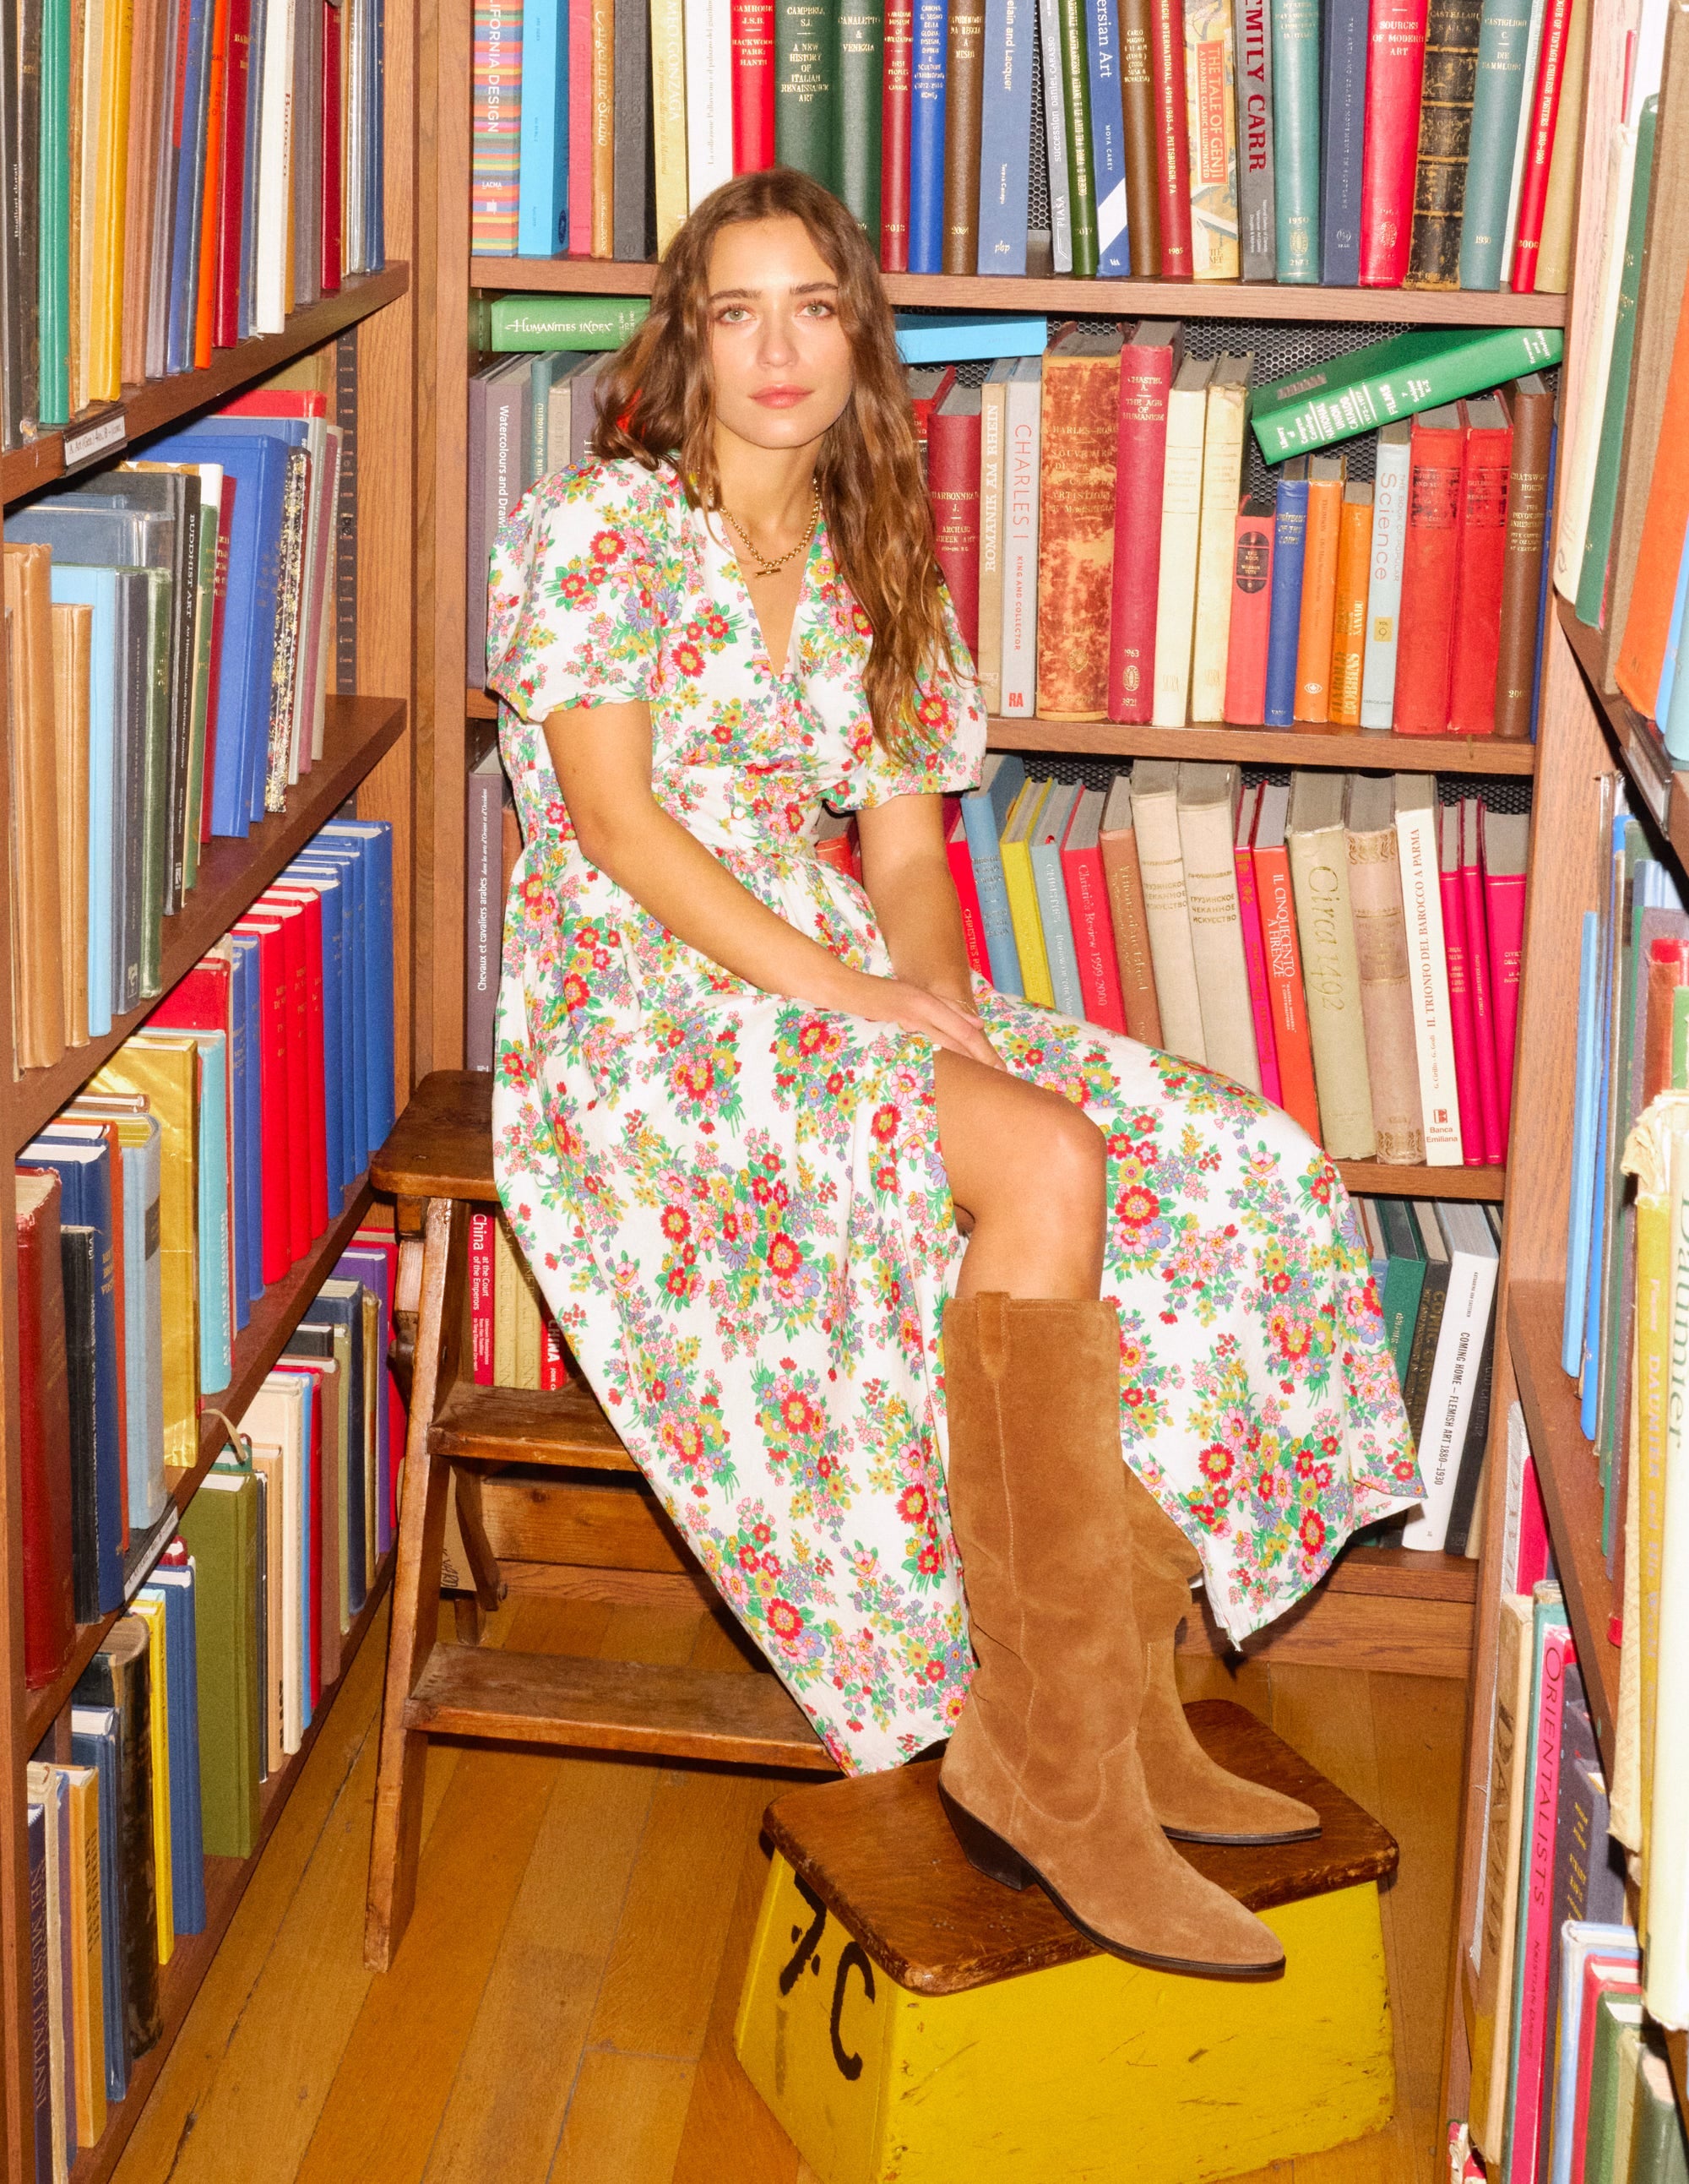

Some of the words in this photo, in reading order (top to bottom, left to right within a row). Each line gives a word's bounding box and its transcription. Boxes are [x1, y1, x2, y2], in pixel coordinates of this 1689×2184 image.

[488, 0, 501, 68] IFORNIA
[855, 30, 863, 39] &
[1005, 27, 1015, 47] and
[1372, 34, 1385, 42] OF
[1388, 34, 1425, 43] MODERN
[1379, 21, 1419, 30] SOURCES
[1553, 19, 1562, 30] OF
[790, 53, 822, 62] HISTORY
[792, 43, 799, 52] A
[801, 43, 818, 52] NEW
[1047, 36, 1056, 73] CARASSO
[1161, 22, 1171, 83] INTERNATIONAL,
[1207, 47, 1220, 74] THE
[1390, 47, 1409, 56] ART
[1548, 31, 1560, 62] VINTAGE
[667, 41, 682, 122] GONZAGA
[801, 64, 812, 73] OF
[1002, 50, 1013, 91] Lacquer
[1099, 52, 1112, 79] Art
[1545, 64, 1556, 94] CHINESE
[487, 75, 500, 133] DESIGN
[798, 94, 813, 102] ART
[1208, 76, 1221, 112] TALE
[1540, 96, 1552, 127] POSTERS
[596, 101, 610, 146] Studio
[1051, 111, 1062, 162] succession
[1209, 115, 1223, 135] OF
[1247, 94, 1267, 173] CARR
[1167, 136, 1176, 182] PITTSBURGH,
[1202, 128, 1210, 178] ILLUMINATED
[1211, 138, 1224, 177] GENJI
[481, 181, 502, 190] LACMA
[1170, 184, 1176, 194] PA
[1056, 195, 1065, 227] PIASA
[1168, 247, 1183, 256] 1985
[505, 317, 576, 334] HUMANITIES
[579, 320, 614, 334] INDEX
[1329, 405, 1345, 430] UNION
[1339, 396, 1359, 430] CATALOG
[1378, 384, 1398, 416] FILMS
[986, 404, 999, 456] RHEIN
[1316, 403, 1336, 439] NATIONAL
[499, 405, 509, 474] Watercolours
[497, 475, 508, 496] and
[986, 463, 997, 489] AM
[1013, 424, 1031, 526] CHARLES
[1396, 495, 1404, 521] BOOK
[985, 494, 997, 573] ROMANIK
[1372, 472, 1398, 581] Science
[1395, 524, 1404, 537] OF
[187, 513, 195, 587] BUDDHIST
[1393, 540, 1403, 582] POPULAR
[1013, 601, 1022, 651] COLLECTOR
[1353, 600, 1363, 636] XANADU
[1008, 693, 1024, 708] RA
[1343, 652, 1360, 715] ROBBINS
[1409, 828, 1422, 867] PARMA
[479, 877, 487, 905] arabes
[1077, 864, 1094, 910] Christie's
[1272, 873, 1284, 885] IL
[1190, 894, 1236, 904] ГРУЗИНСКОЕ
[1192, 904, 1236, 913] ЧЕКАННОЕ
[1306, 865, 1340, 945] Circa
[1415, 880, 1427, 935] BAROCCO
[478, 905, 487, 943] cavaliers
[1084, 912, 1098, 948] Review
[1192, 914, 1237, 924] ИСКУССТВО
[1267, 918, 1279, 926] A
[1274, 887, 1295, 977] CINQUECENTO
[478, 944, 487, 953] et
[1268, 931, 1284, 978] FIRENZE
[1420, 938, 1430, 960] DEL
[477, 955, 487, 991] Chevaux
[1307, 953, 1344, 1011] 1492
[1422, 963, 1435, 1014] TRIONFO
[1426, 1017, 1436, 1027] IL
[471, 1213, 487, 1251] China
[473, 1256, 481, 1264] of
[481, 1265, 490, 1276] the
[471, 1278, 481, 1310] Emperors
[481, 1278, 491, 1296] Court
[546, 1319, 561, 1363] CHINA
[1456, 1332, 1470, 1361] COMING
[1451, 1364, 1463, 1385] HOME
[1444, 1395, 1459, 1427] FLEMISH
[1648, 1355, 1660, 1479] DAUMIER
[1441, 1429, 1452, 1442] ART
[1433, 1445, 1450, 1486] 1880–1930
[1647, 1491, 1657, 1529] and
[1647, 1541, 1657, 1577] His
[1533, 1647, 1561, 1906] ORIENTALISTS
[30, 1864, 44, 1909] NEI
[30, 1918, 46, 1997] MUSEI
[1529, 1940, 1541, 2003] KRISTIAN
[32, 2004, 46, 2110] ITALIANI
